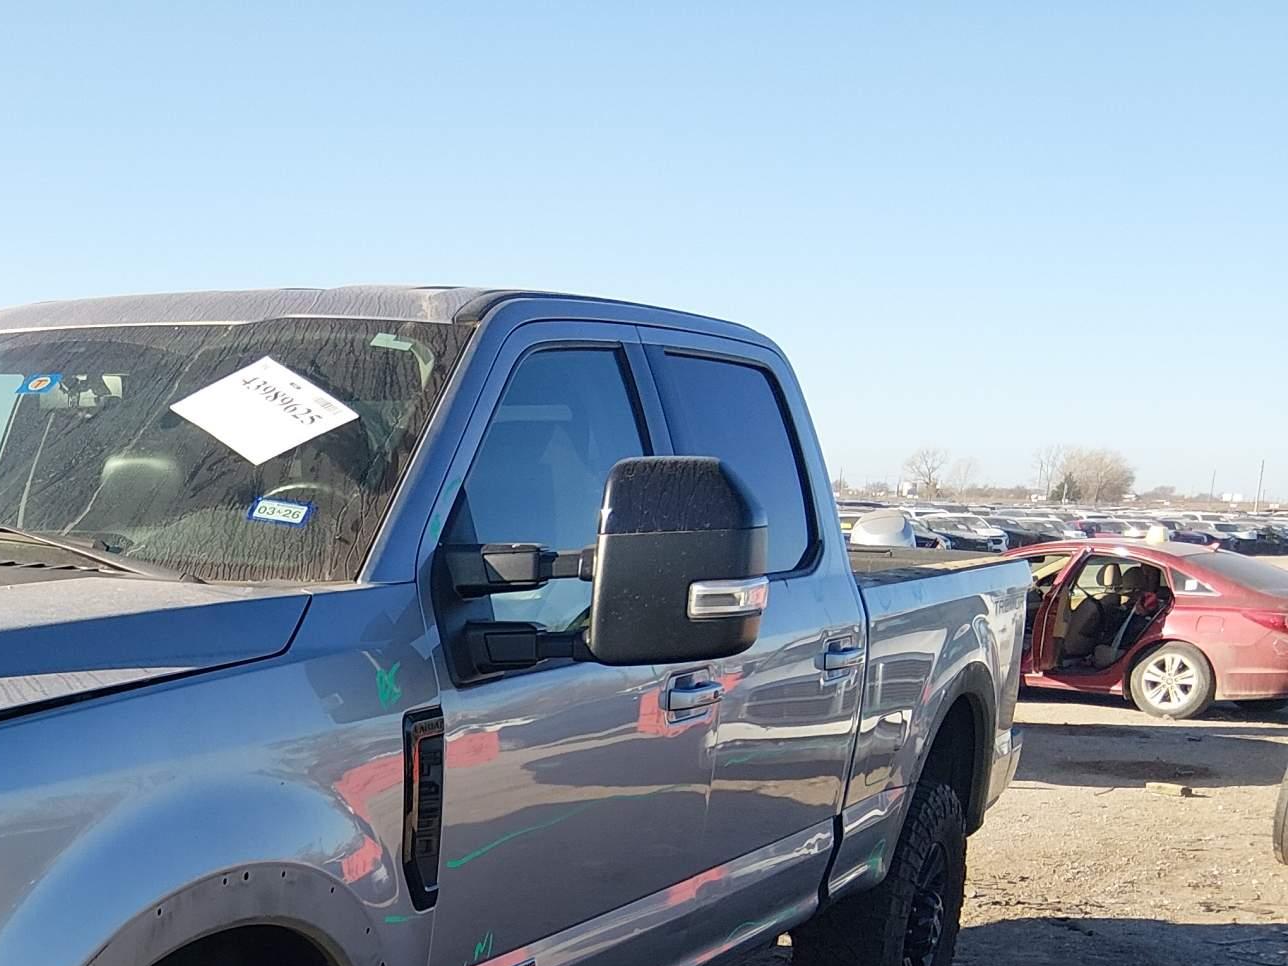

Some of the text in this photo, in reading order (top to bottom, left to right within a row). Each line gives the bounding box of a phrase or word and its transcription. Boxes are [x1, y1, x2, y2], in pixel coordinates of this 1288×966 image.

[242, 376, 323, 425] 43989625
[257, 505, 301, 519] 03 26
